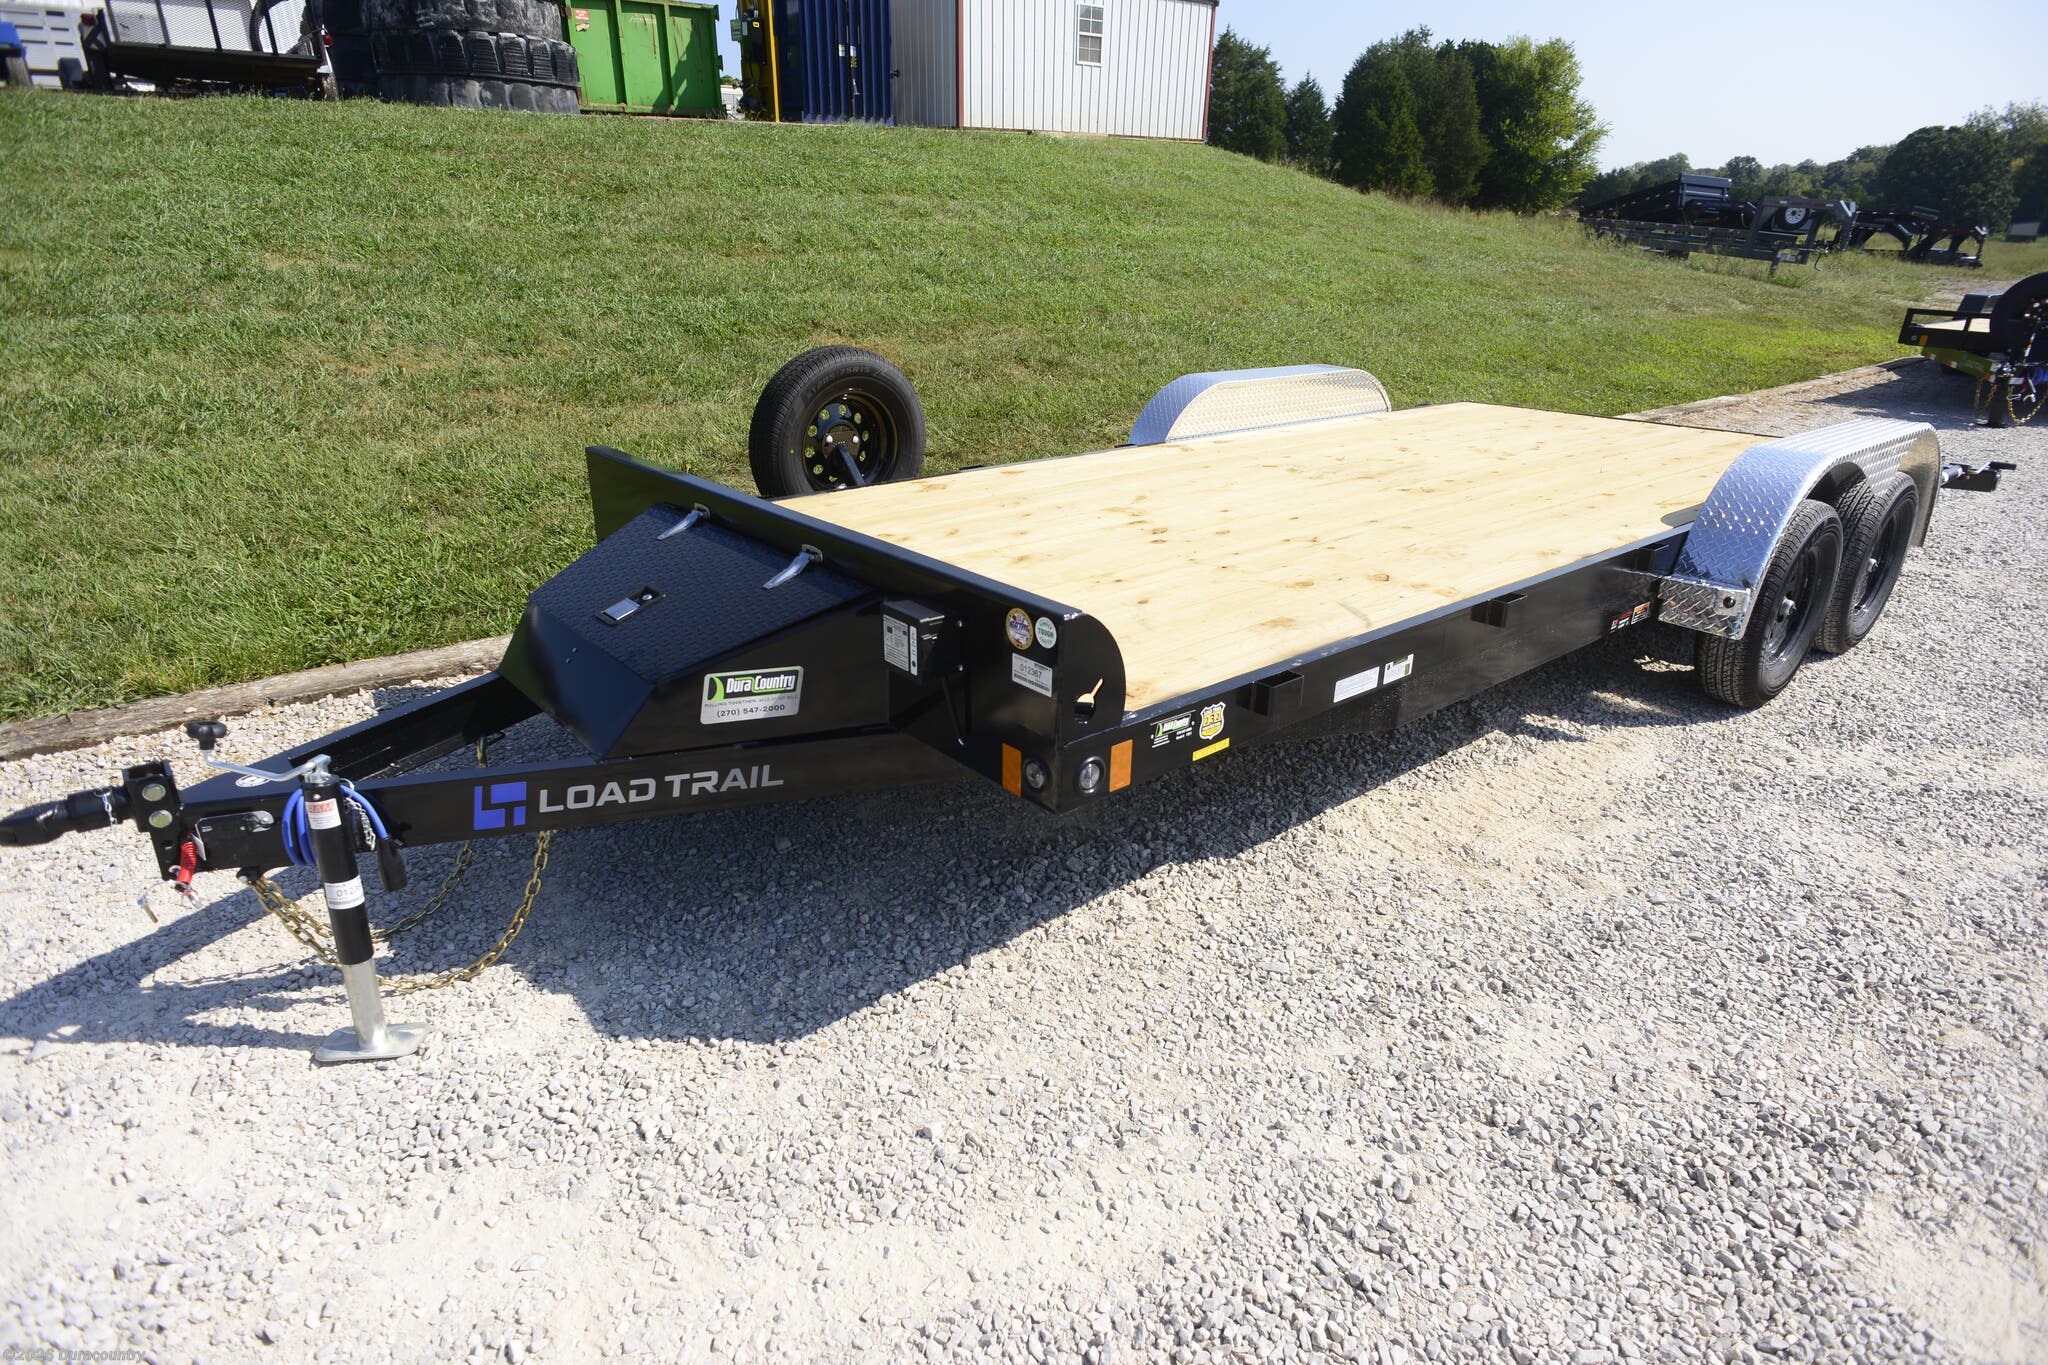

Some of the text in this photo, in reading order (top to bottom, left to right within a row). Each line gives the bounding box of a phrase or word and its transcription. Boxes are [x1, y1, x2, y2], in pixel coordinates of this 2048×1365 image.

[725, 674, 796, 693] Dura Country
[716, 704, 786, 718] (270) 547-2000
[539, 778, 656, 813] LOAD
[664, 765, 784, 798] TRAIL
